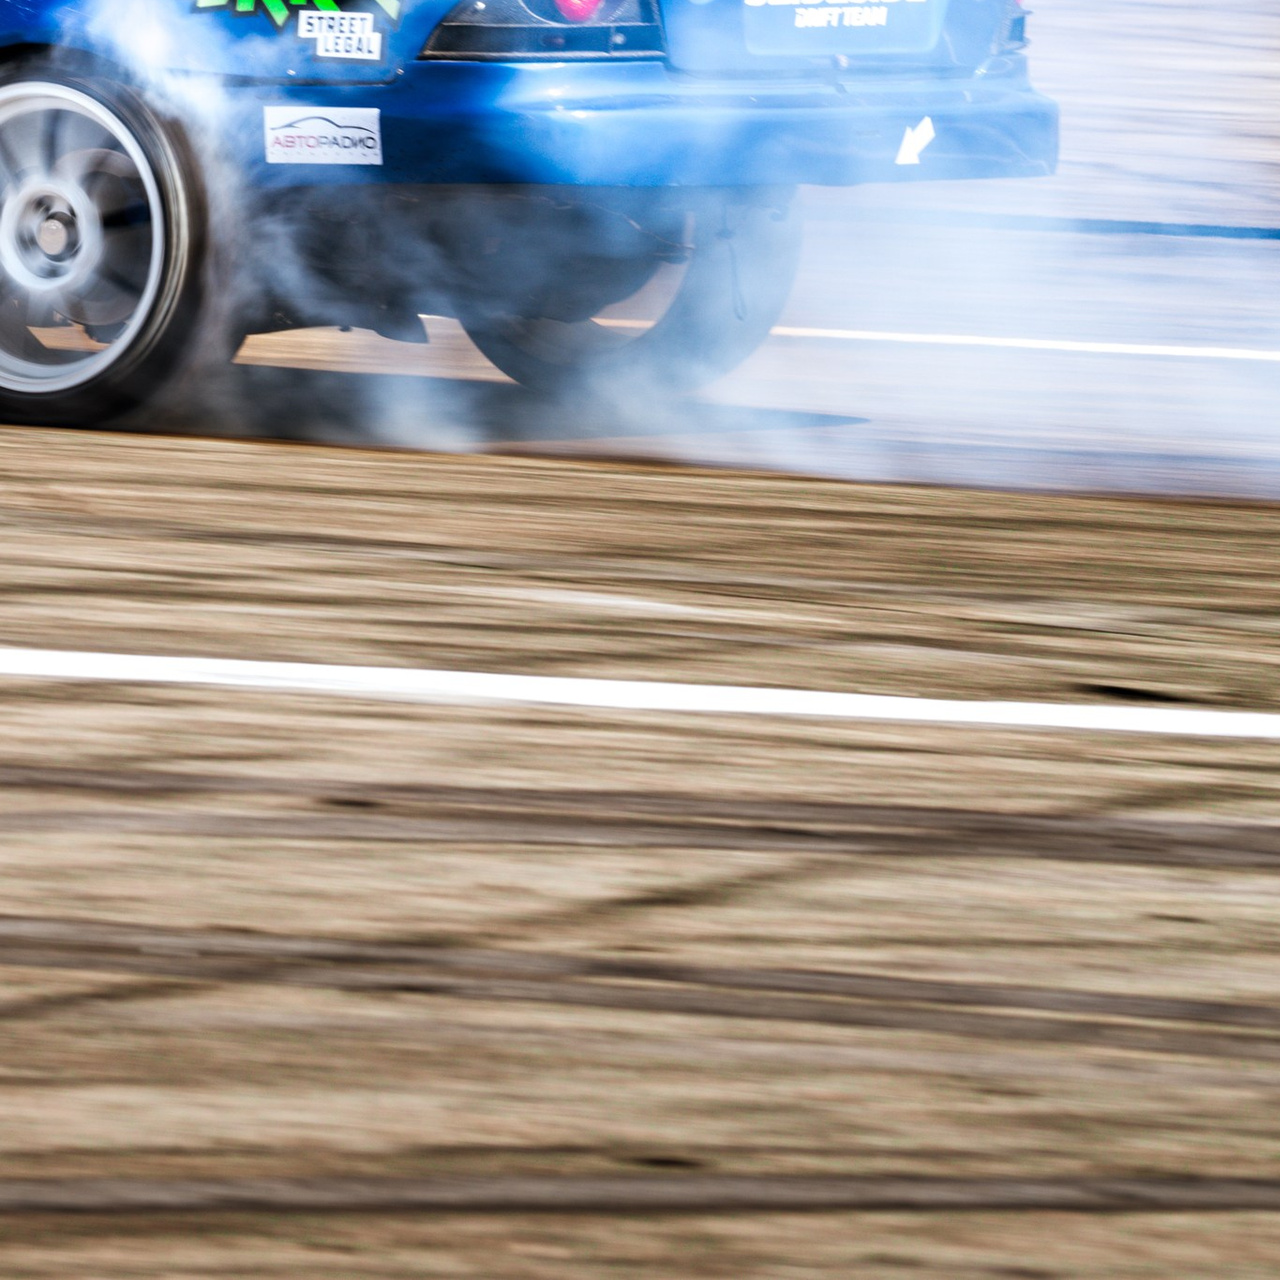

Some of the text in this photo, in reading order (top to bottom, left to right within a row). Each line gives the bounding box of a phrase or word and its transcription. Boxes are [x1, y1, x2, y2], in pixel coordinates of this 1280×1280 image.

[306, 15, 368, 35] STREET
[324, 36, 374, 55] LEGAL
[273, 135, 378, 150] АВТОРАДИО
